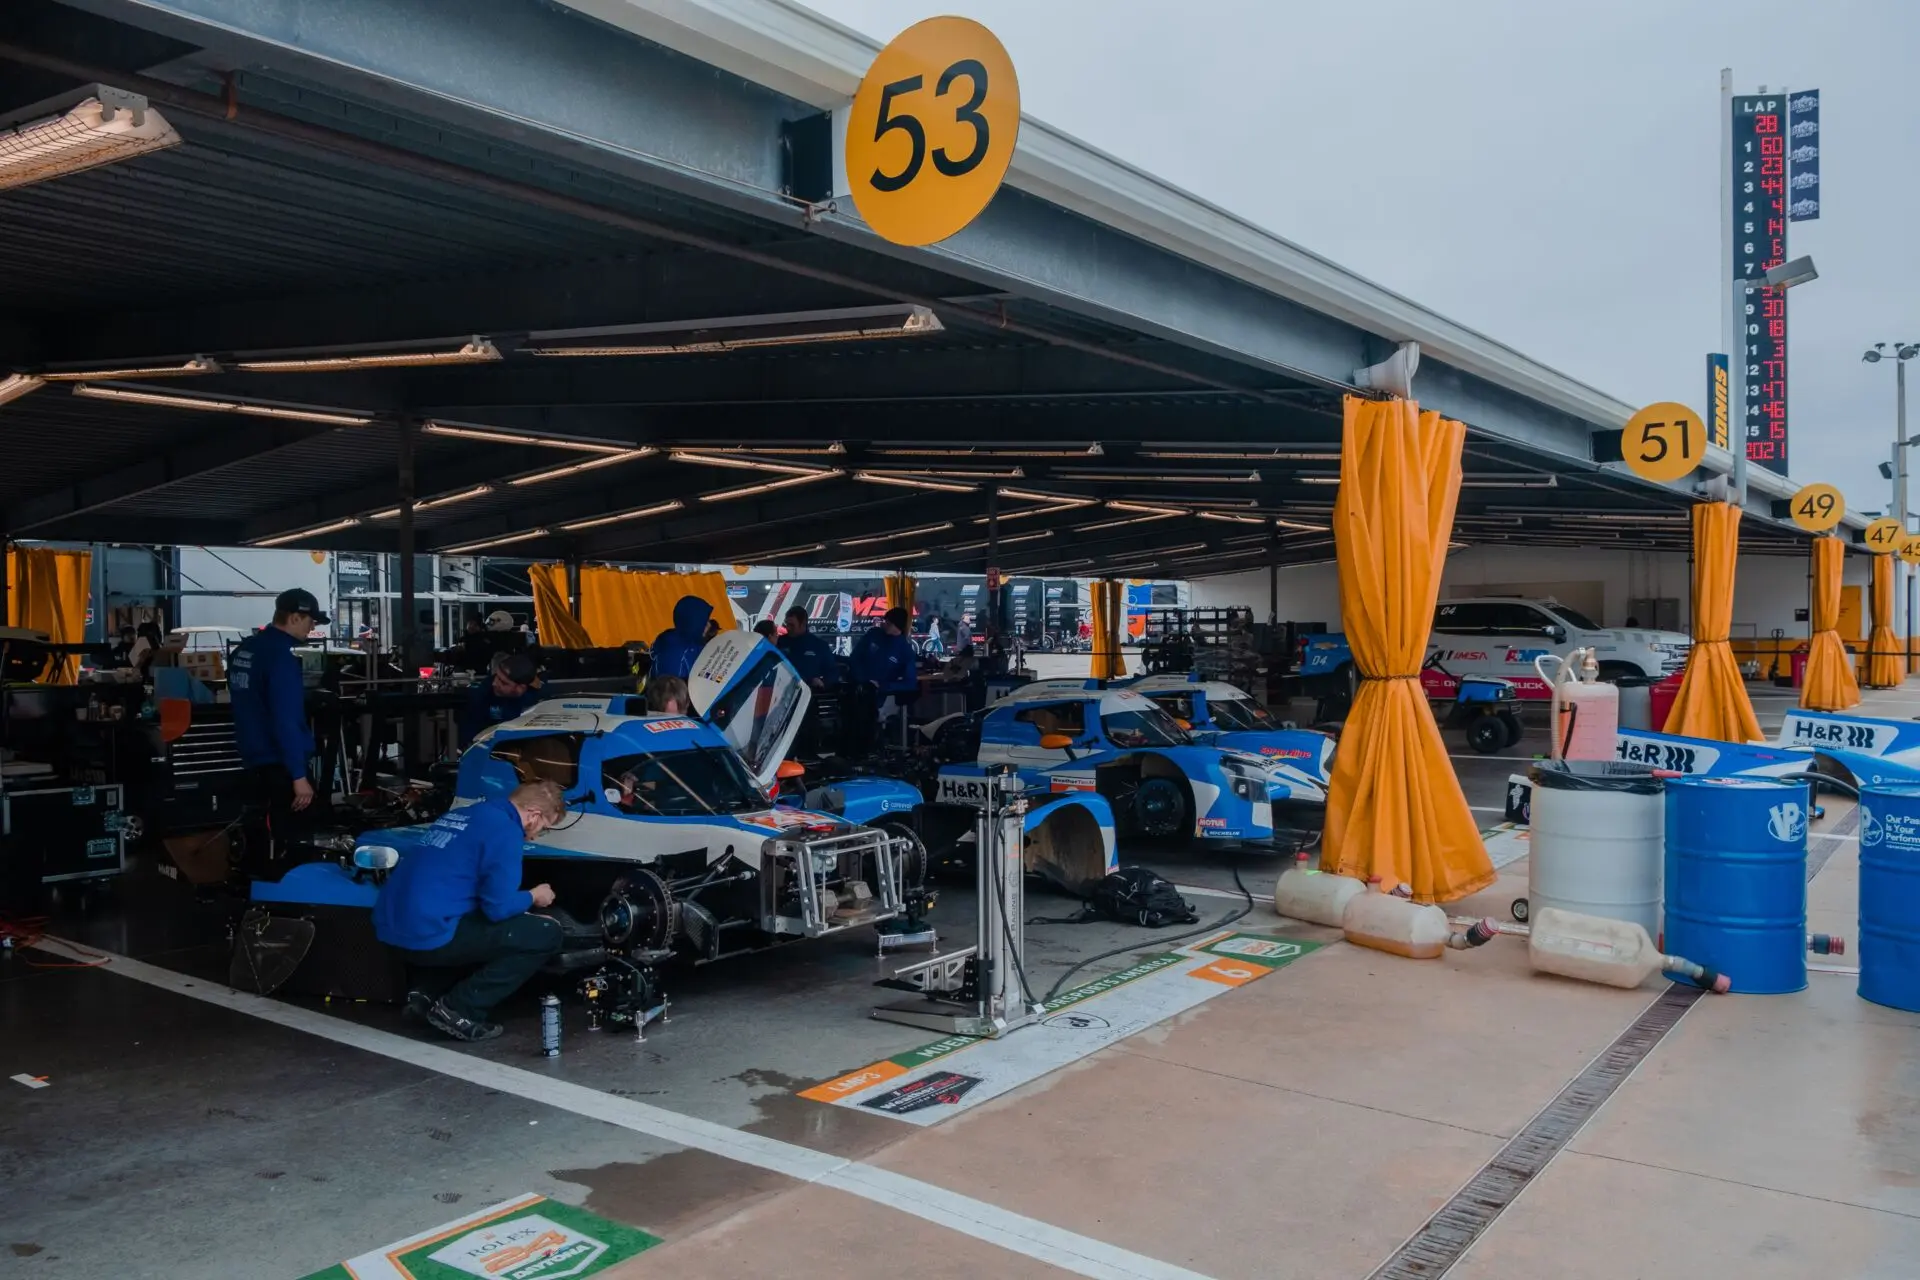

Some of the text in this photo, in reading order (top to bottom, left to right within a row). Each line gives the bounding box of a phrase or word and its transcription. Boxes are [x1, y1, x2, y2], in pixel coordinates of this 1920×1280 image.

[1744, 101, 1777, 112] LAP
[869, 58, 990, 192] 53
[1755, 115, 1778, 133] 28
[1744, 137, 1783, 154] 1 60
[1744, 157, 1783, 174] 2 23
[1744, 178, 1783, 194] 3 44
[1744, 198, 1784, 215] 4 4
[1744, 218, 1784, 235] 5 14
[1744, 238, 1784, 256] 6 6
[1744, 263, 1754, 274] 7
[1745, 299, 1785, 317] 9 30
[1769, 319, 1785, 337] 18
[1773, 340, 1785, 357] 3
[1762, 360, 1785, 378] 77
[1762, 381, 1785, 399] 47
[1762, 401, 1785, 419] 46
[1769, 421, 1785, 439] 15
[1640, 419, 1690, 463] 51
[1798, 493, 1835, 519] 49
[1871, 526, 1899, 544] 47
[1440, 606, 1457, 616] 04
[1311, 655, 1328, 665] 04
[1453, 650, 1488, 660] IMSA
[1795, 721, 1843, 742] H&R
[943, 780, 979, 799] H&R
[1200, 818, 1225, 827] MOTUL
[1769, 802, 1799, 841] VP
[1886, 814, 1902, 824] Our
[1886, 823, 1916, 834] Is Your
[1115, 956, 1177, 982] AMERICA
[1209, 966, 1253, 979] 6
[828, 1072, 881, 1092] LMP3
[467, 1227, 537, 1257] ROLEX
[512, 1244, 592, 1280] DAYTONA
